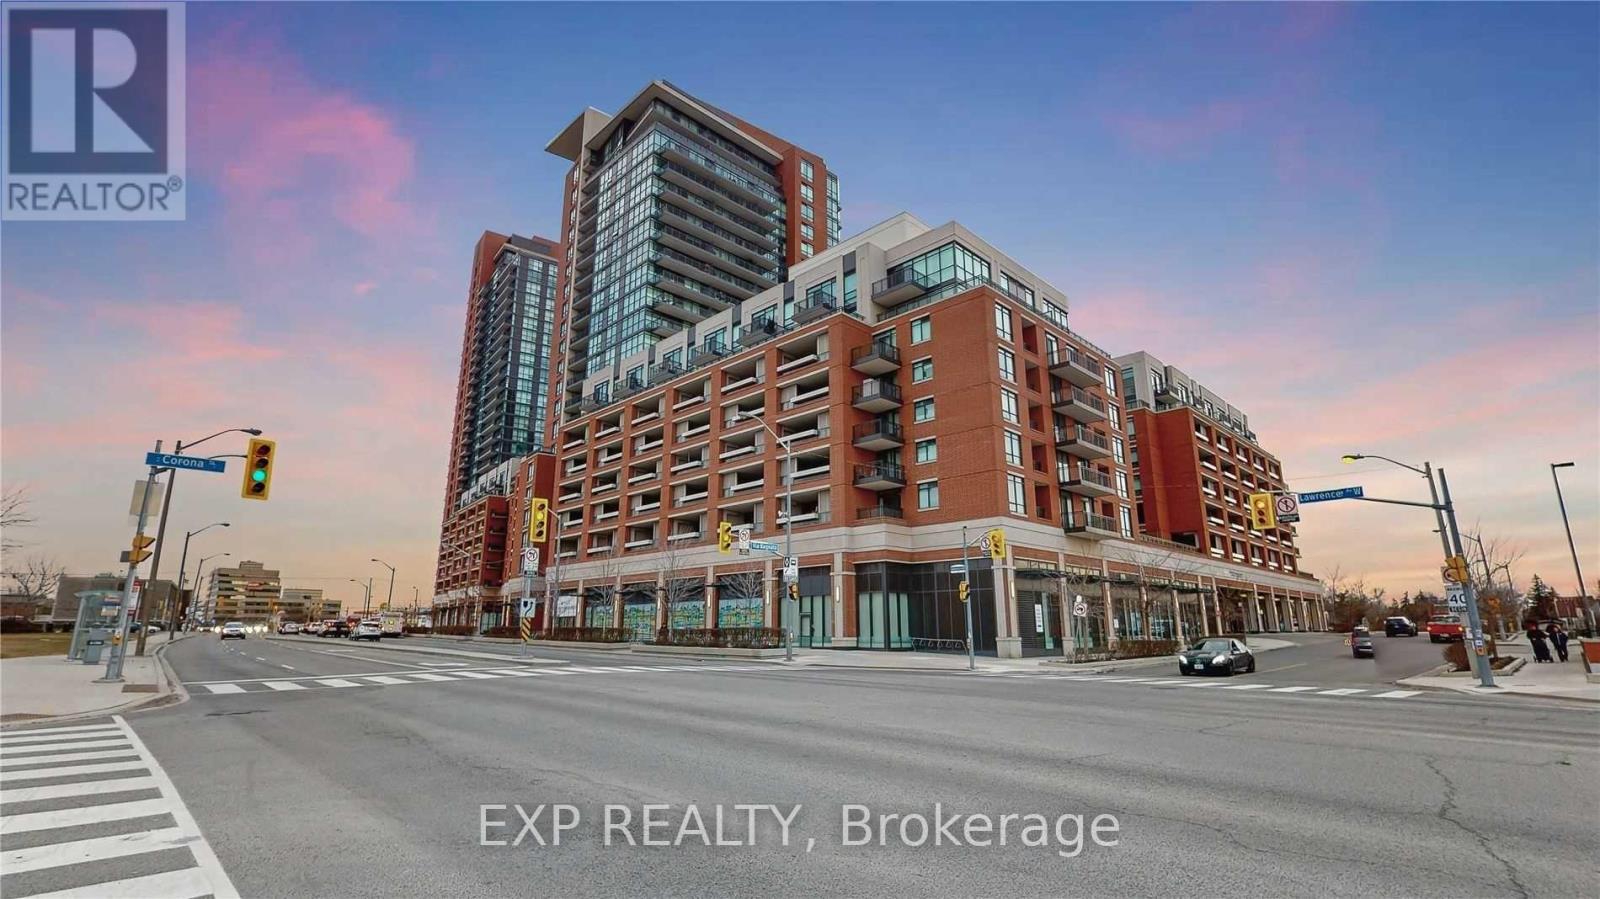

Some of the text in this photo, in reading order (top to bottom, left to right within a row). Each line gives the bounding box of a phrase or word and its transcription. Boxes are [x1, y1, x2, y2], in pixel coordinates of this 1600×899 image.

[162, 455, 204, 468] Corona
[1300, 487, 1361, 502] Lawrence W
